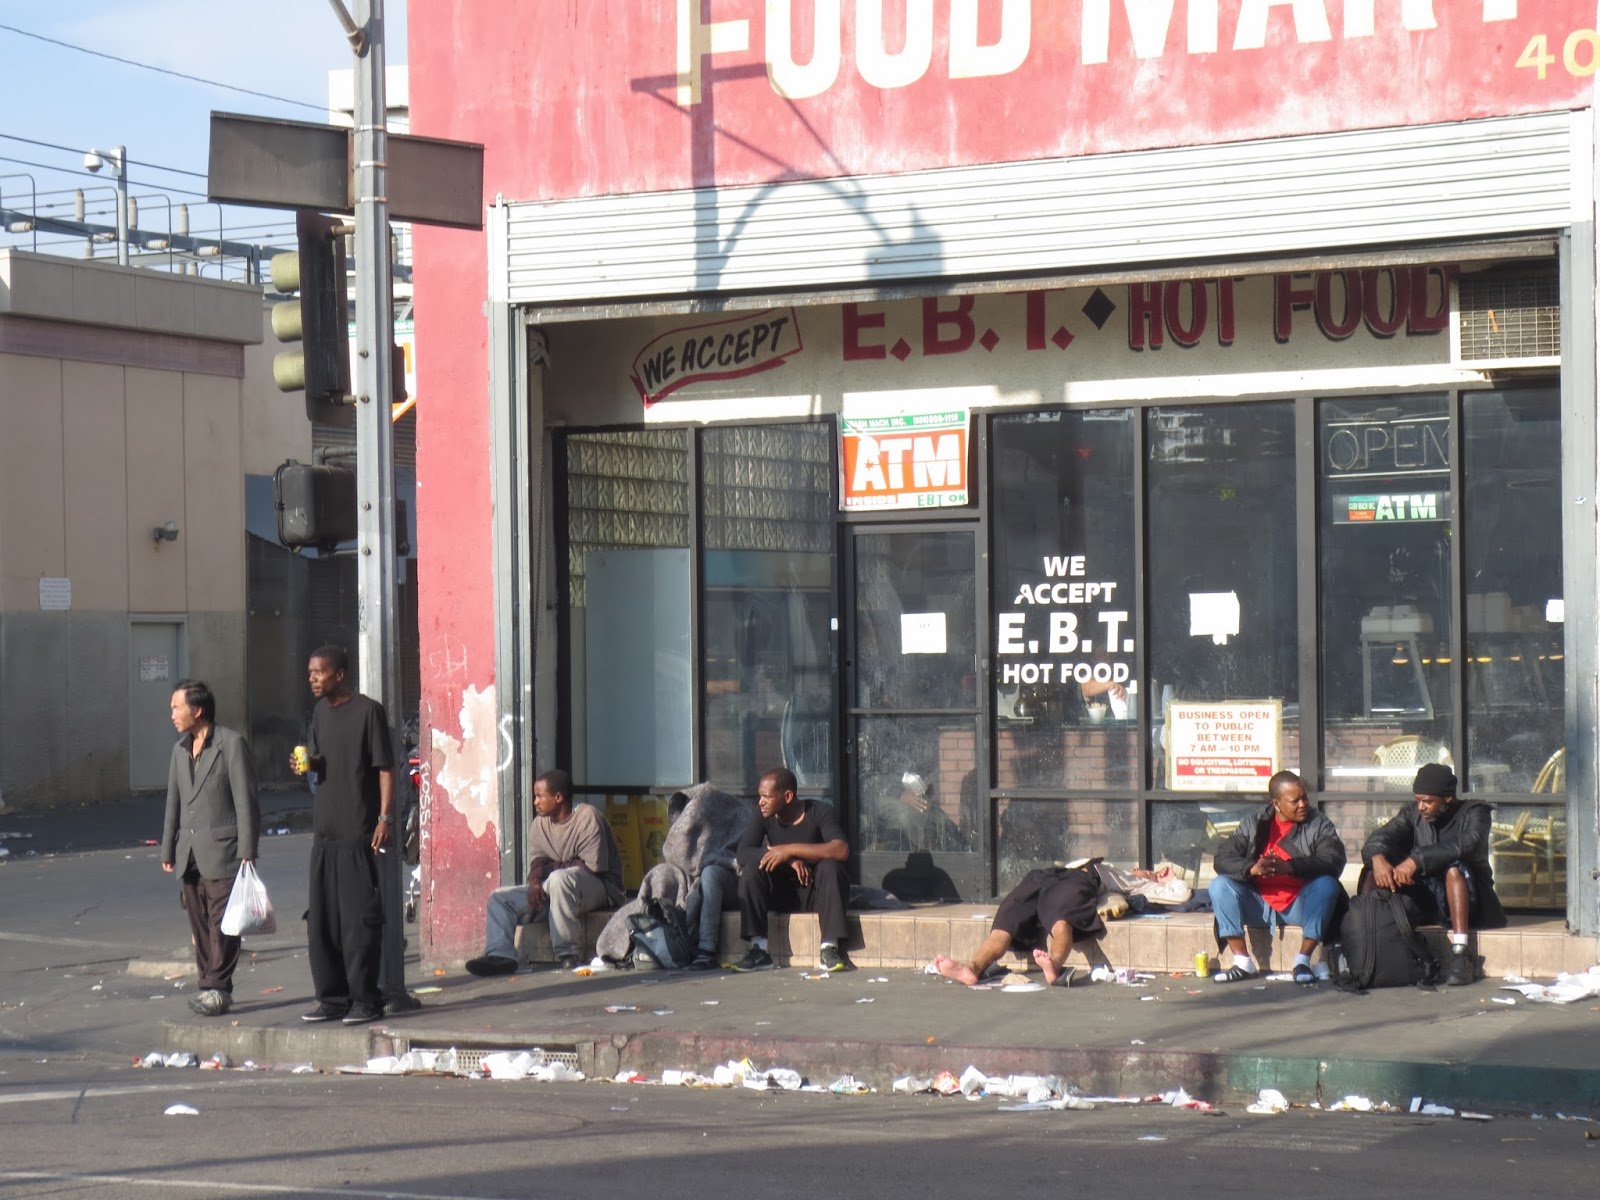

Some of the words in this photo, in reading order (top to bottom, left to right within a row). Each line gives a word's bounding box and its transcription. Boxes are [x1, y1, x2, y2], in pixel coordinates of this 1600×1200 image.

[677, 0, 1031, 106] FOOD
[1127, 276, 1245, 351] HOT
[1274, 264, 1458, 344] FOOD
[643, 346, 676, 390] WE
[680, 316, 789, 372] ACCEPT
[852, 434, 960, 491] ATM
[845, 495, 896, 506] INSIDE
[917, 494, 943, 507] EBT
[948, 494, 966, 504] OK
[1375, 494, 1436, 520] ATM
[1043, 556, 1086, 577] WE
[1014, 582, 1117, 604] ACCEPT
[1003, 663, 1054, 684] HOT
[1060, 663, 1129, 684] FOOD
[1178, 711, 1233, 720] BUSINESS
[1239, 711, 1270, 719] OPEN
[1195, 722, 1209, 730] TO
[1215, 722, 1254, 730] PUBLIC
[1194, 767, 1205, 775] OR
[1233, 759, 1270, 767] LOITERING
